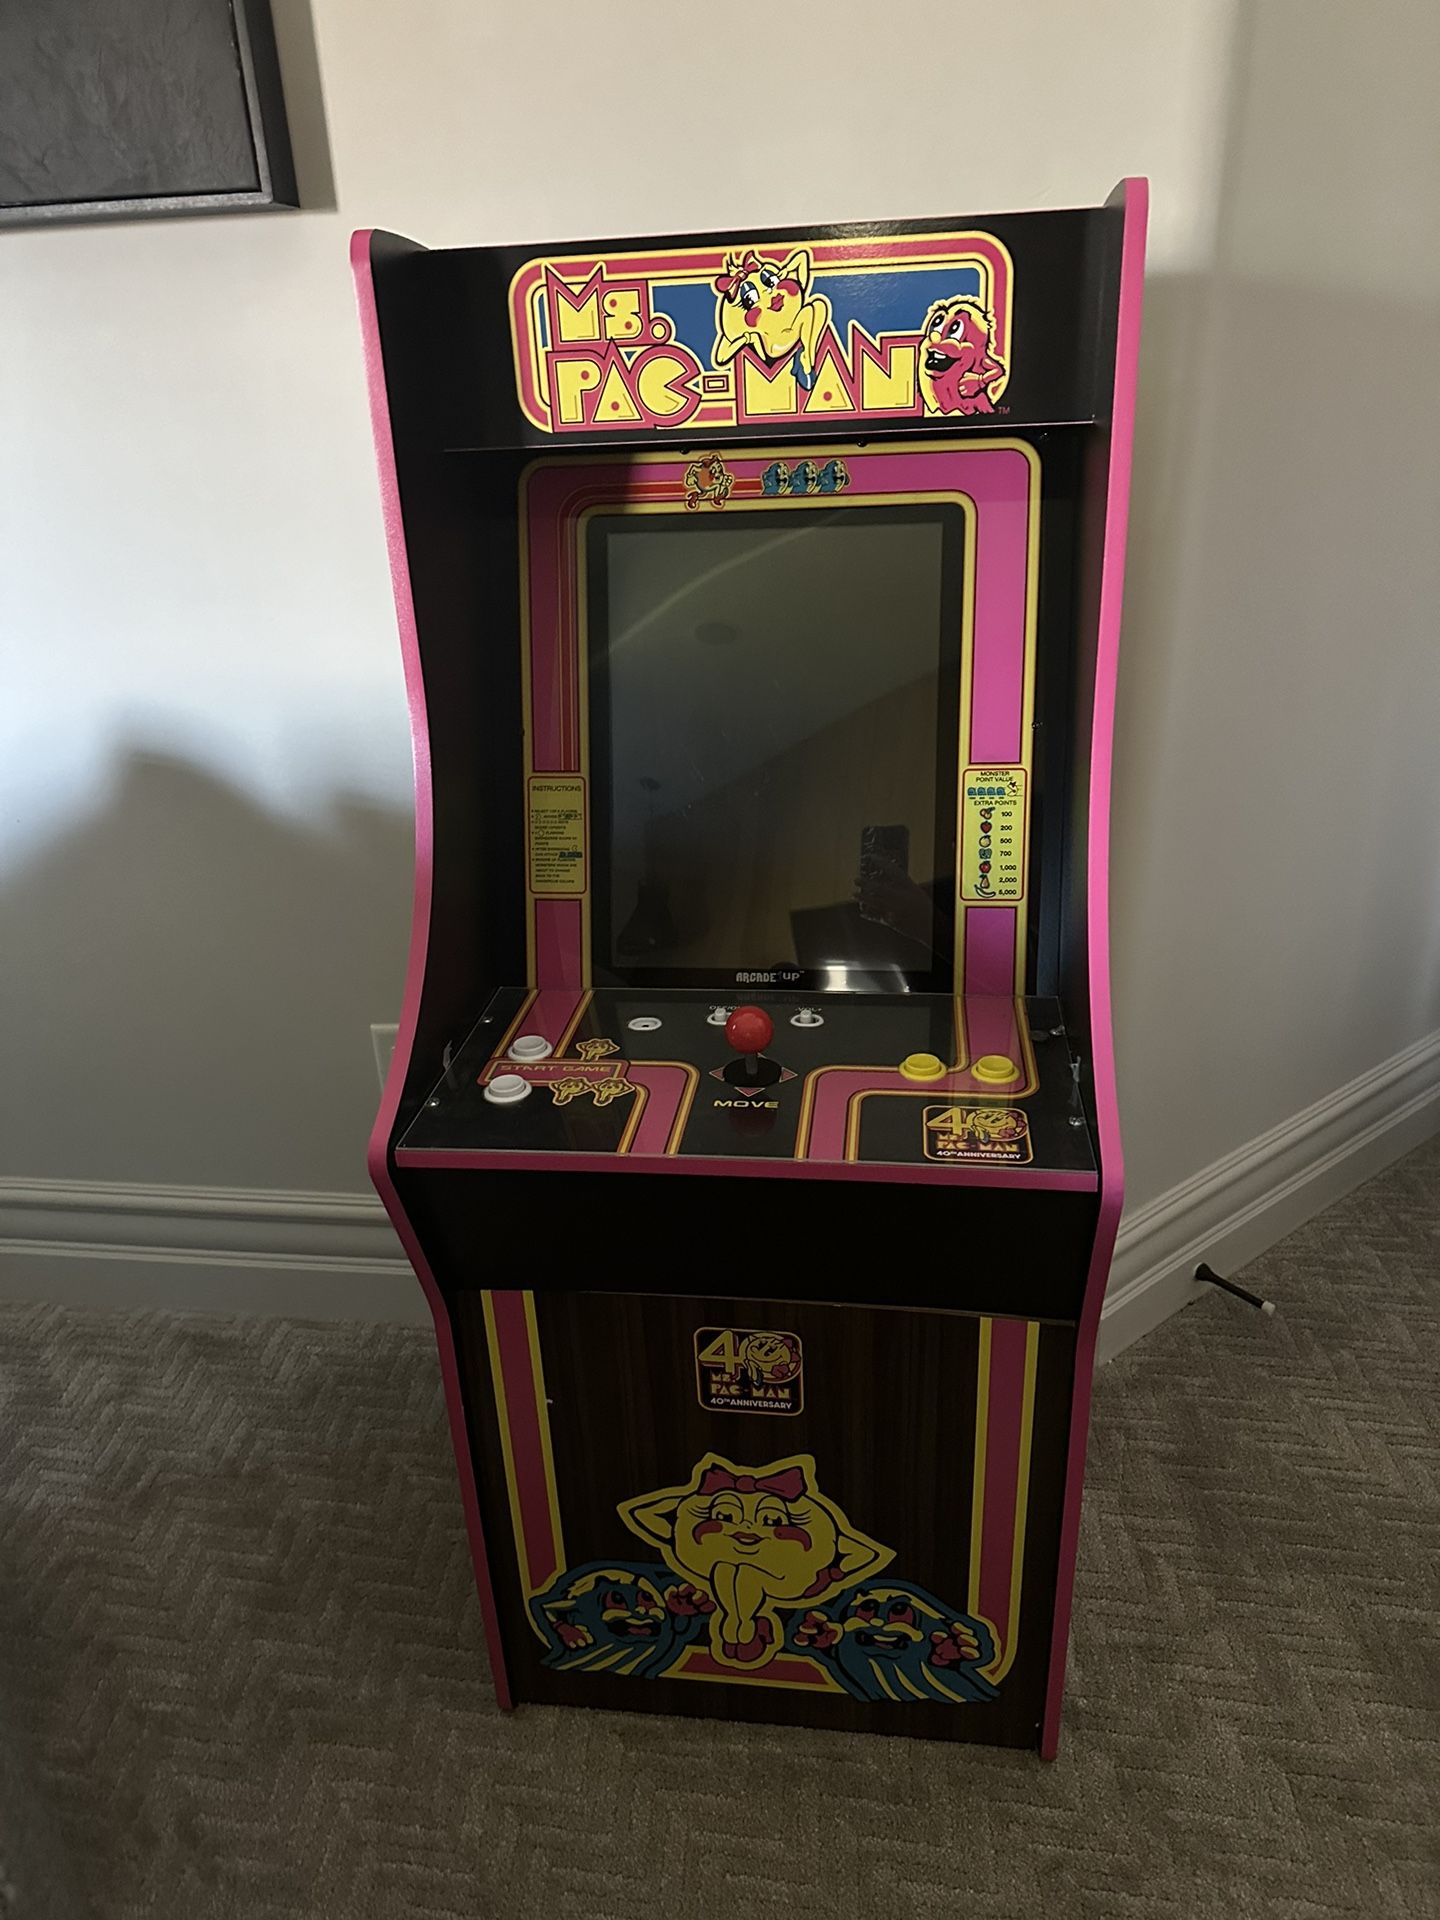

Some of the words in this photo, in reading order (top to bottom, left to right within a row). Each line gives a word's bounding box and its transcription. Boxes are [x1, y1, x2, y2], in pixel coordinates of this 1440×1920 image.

[553, 336, 920, 426] PAC-MAN
[562, 1065, 611, 1073] GAME
[713, 1100, 779, 1109] MOVE
[730, 1399, 792, 1409] ANNIVERSARY
